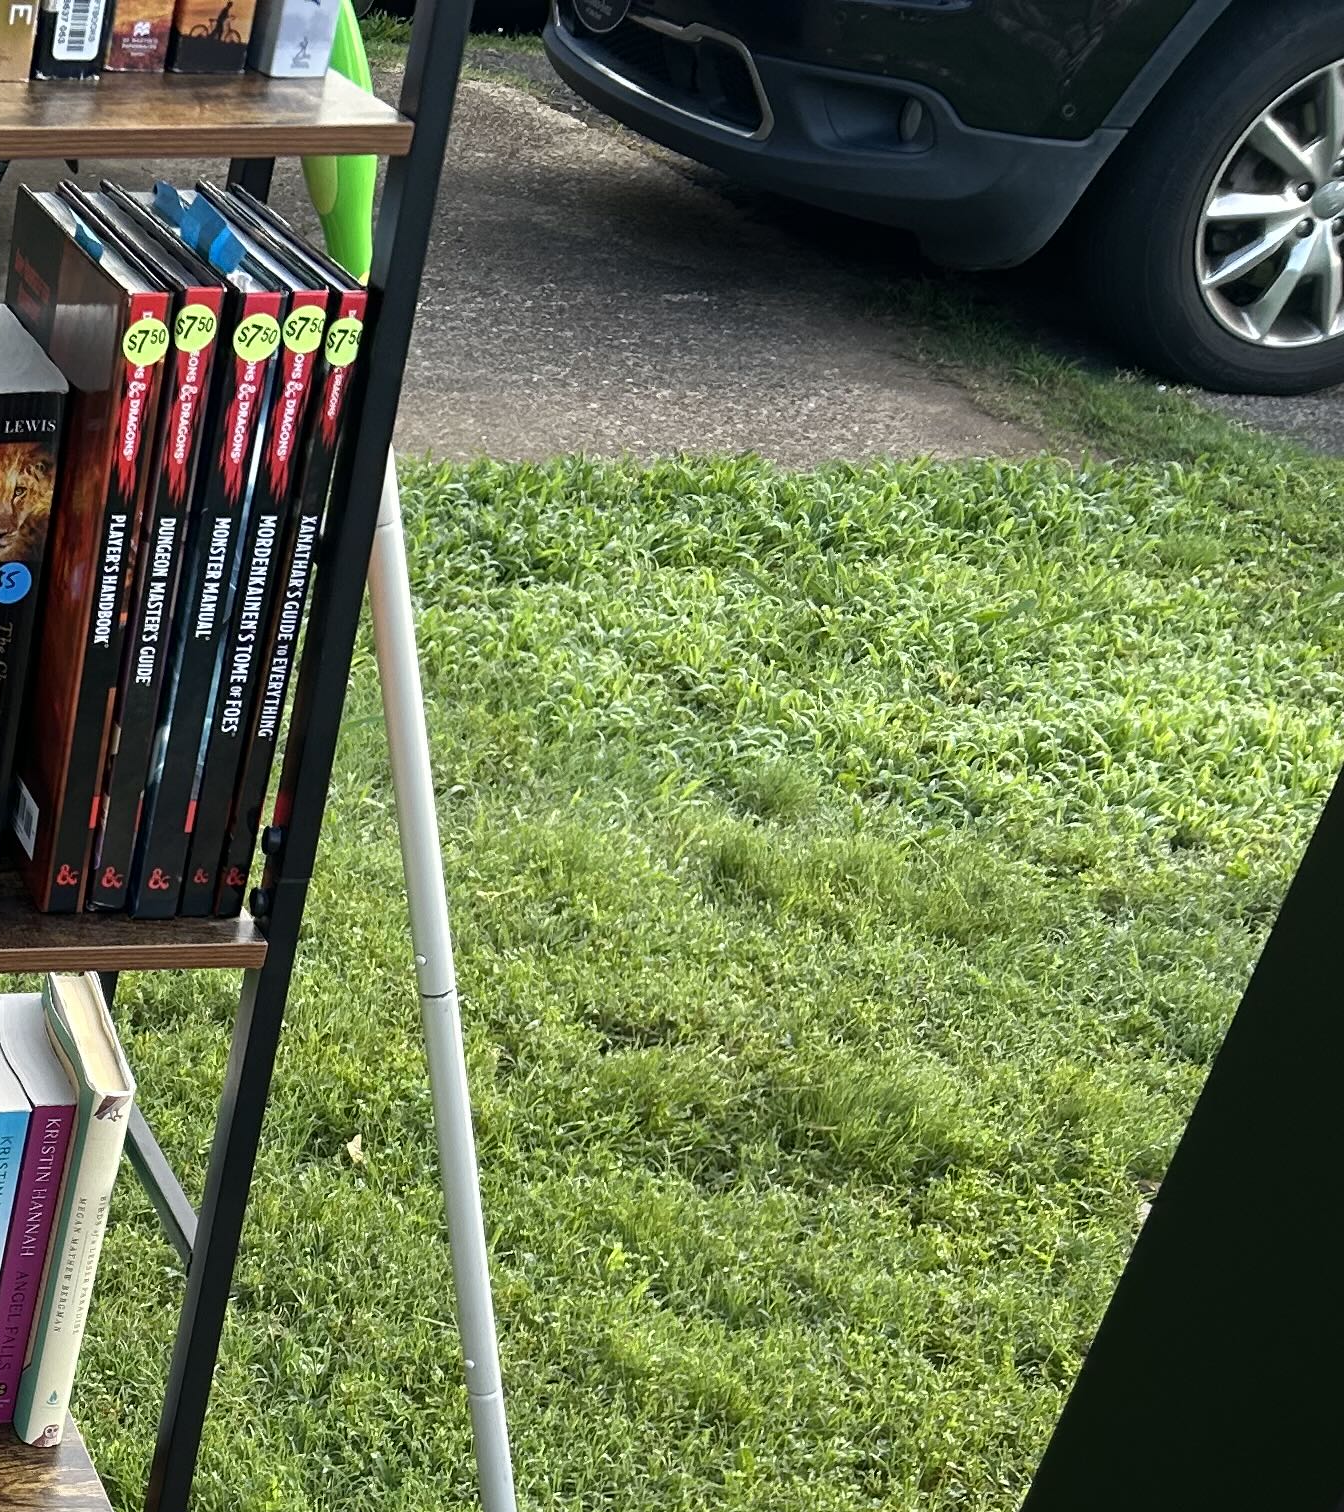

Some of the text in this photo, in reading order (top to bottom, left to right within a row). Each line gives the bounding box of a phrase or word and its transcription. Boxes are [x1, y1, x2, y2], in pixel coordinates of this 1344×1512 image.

[4, 418, 56, 434] LEWIS
[152, 517, 177, 577] DUNGEON
[205, 517, 232, 580] MONSTER
[94, 575, 118, 645] HANDBOOK
[277, 601, 300, 656] GUIDE TO
[230, 646, 253, 698] TOME OF
[19, 1118, 63, 1258] KRISTIN HANNAH
